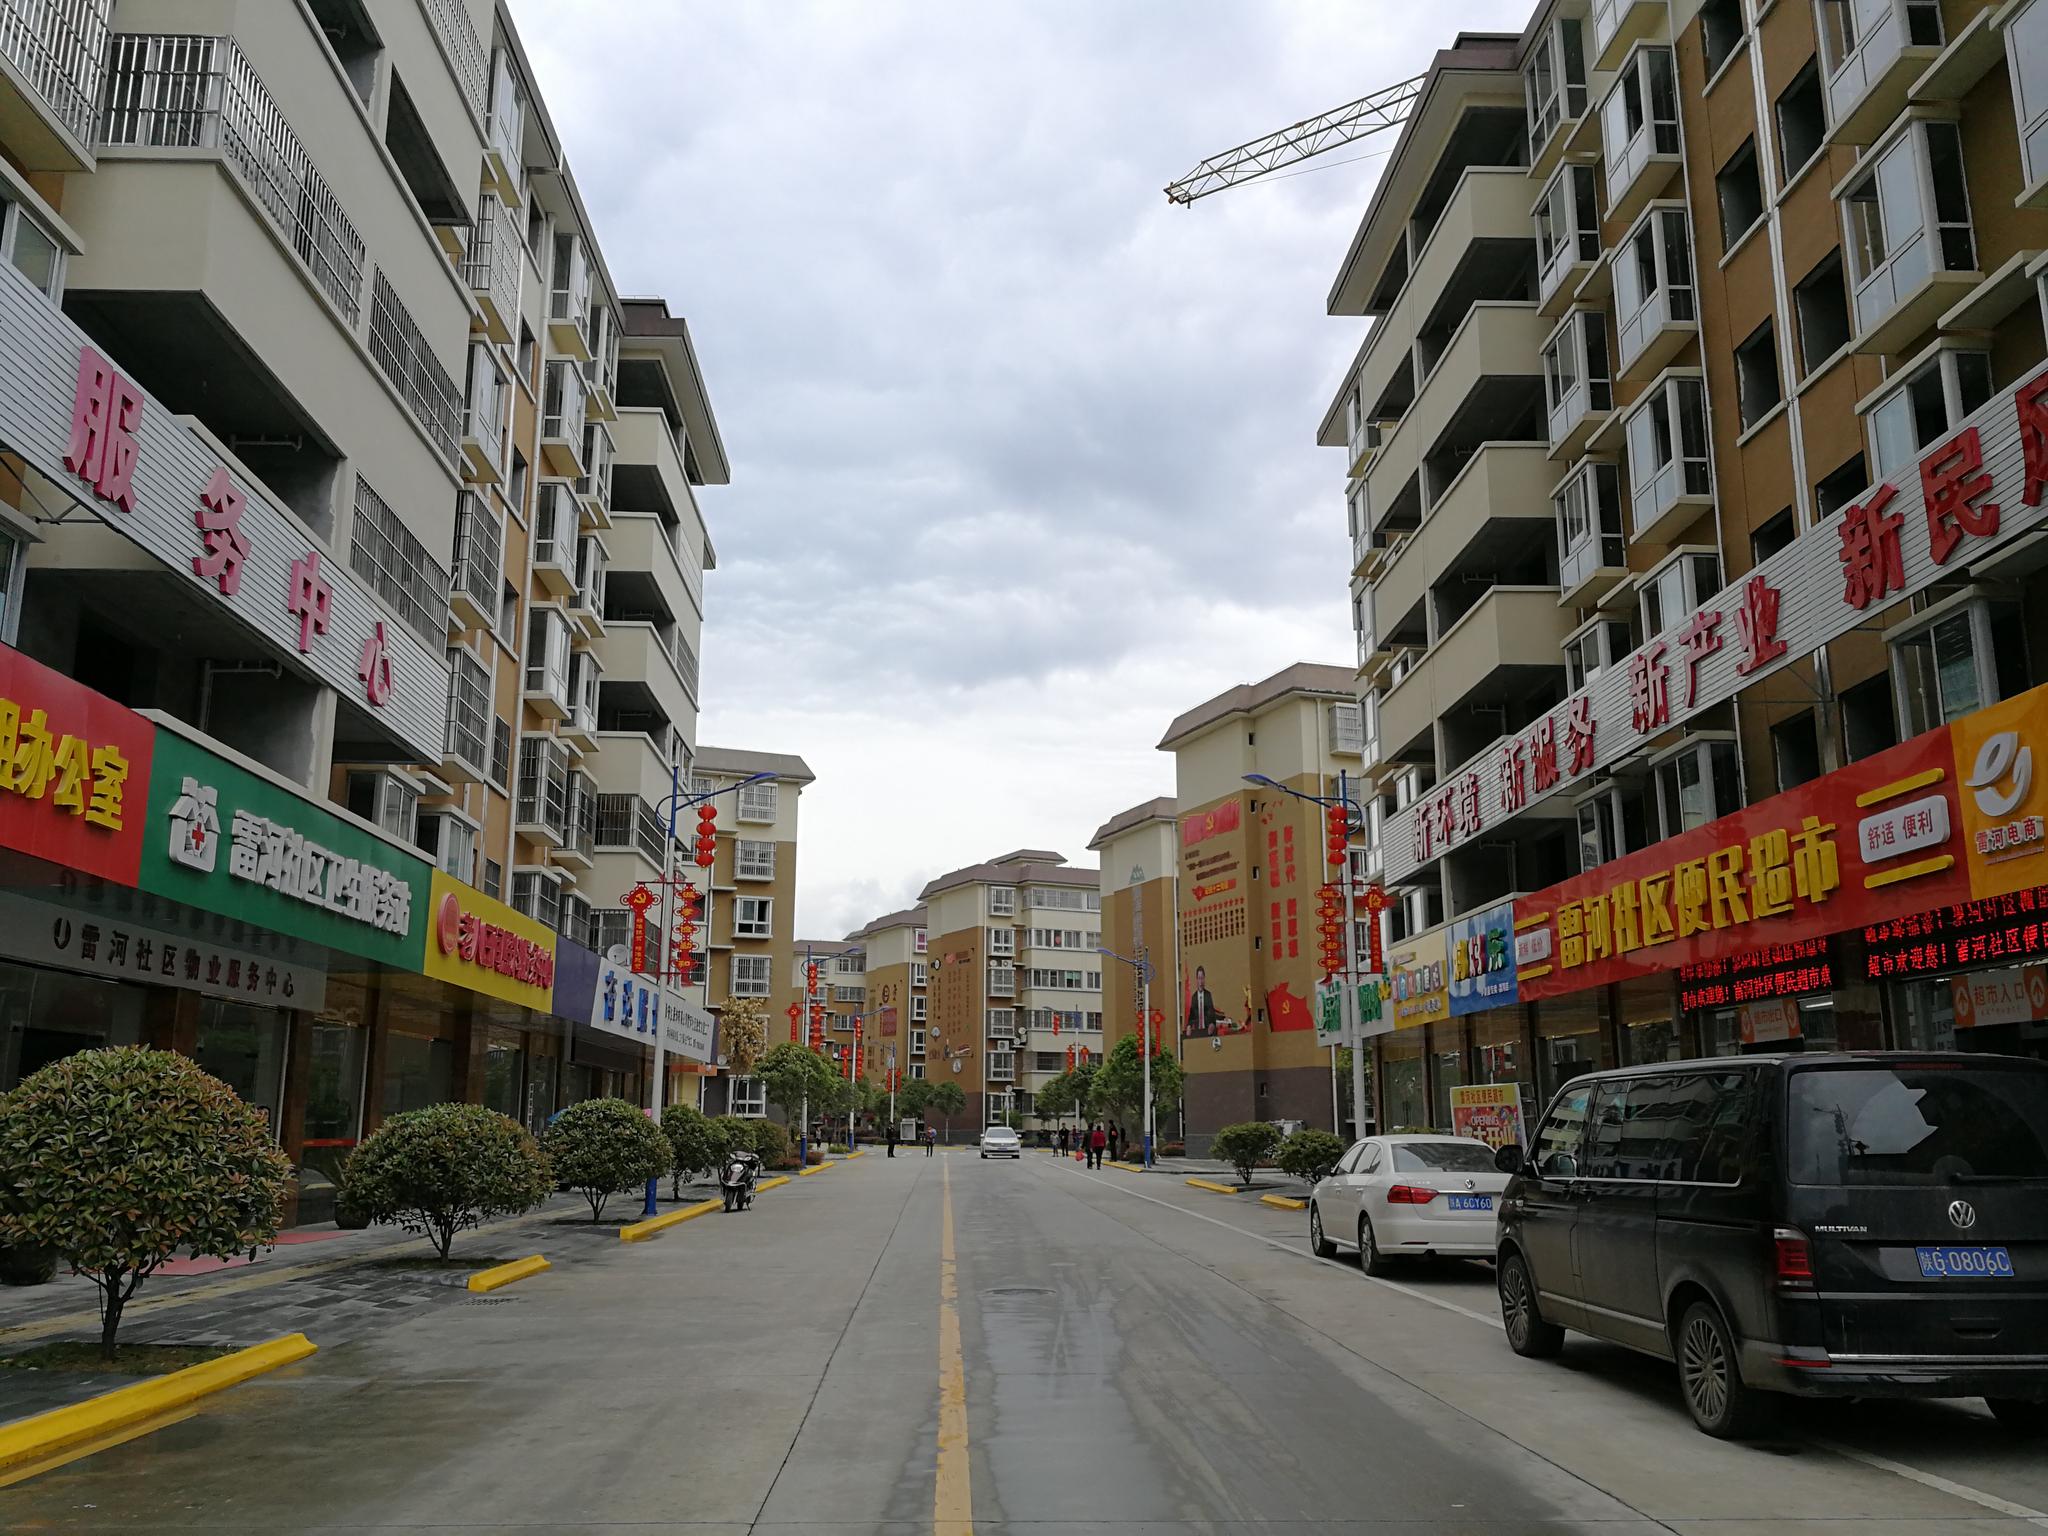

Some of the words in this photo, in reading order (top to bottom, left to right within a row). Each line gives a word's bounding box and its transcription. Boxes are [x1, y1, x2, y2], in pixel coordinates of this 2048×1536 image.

[63, 345, 396, 708] 服务中心
[1411, 771, 1481, 863] 新环境
[1500, 695, 1598, 814] 新服务
[1627, 574, 1788, 736] 新产业
[1868, 821, 1896, 851] 舒适
[1903, 808, 1933, 840] 便利
[1975, 816, 2042, 855] 雷河电商
[229, 808, 411, 937] 雷河社区卫生服务站
[1556, 815, 1841, 970] 雷河社区便民超市
[81, 923, 295, 998] 雷河社区物业服务中心
[1974, 983, 2024, 1007] 超市入口
[1814, 1224, 1869, 1233] MULTIVAN
